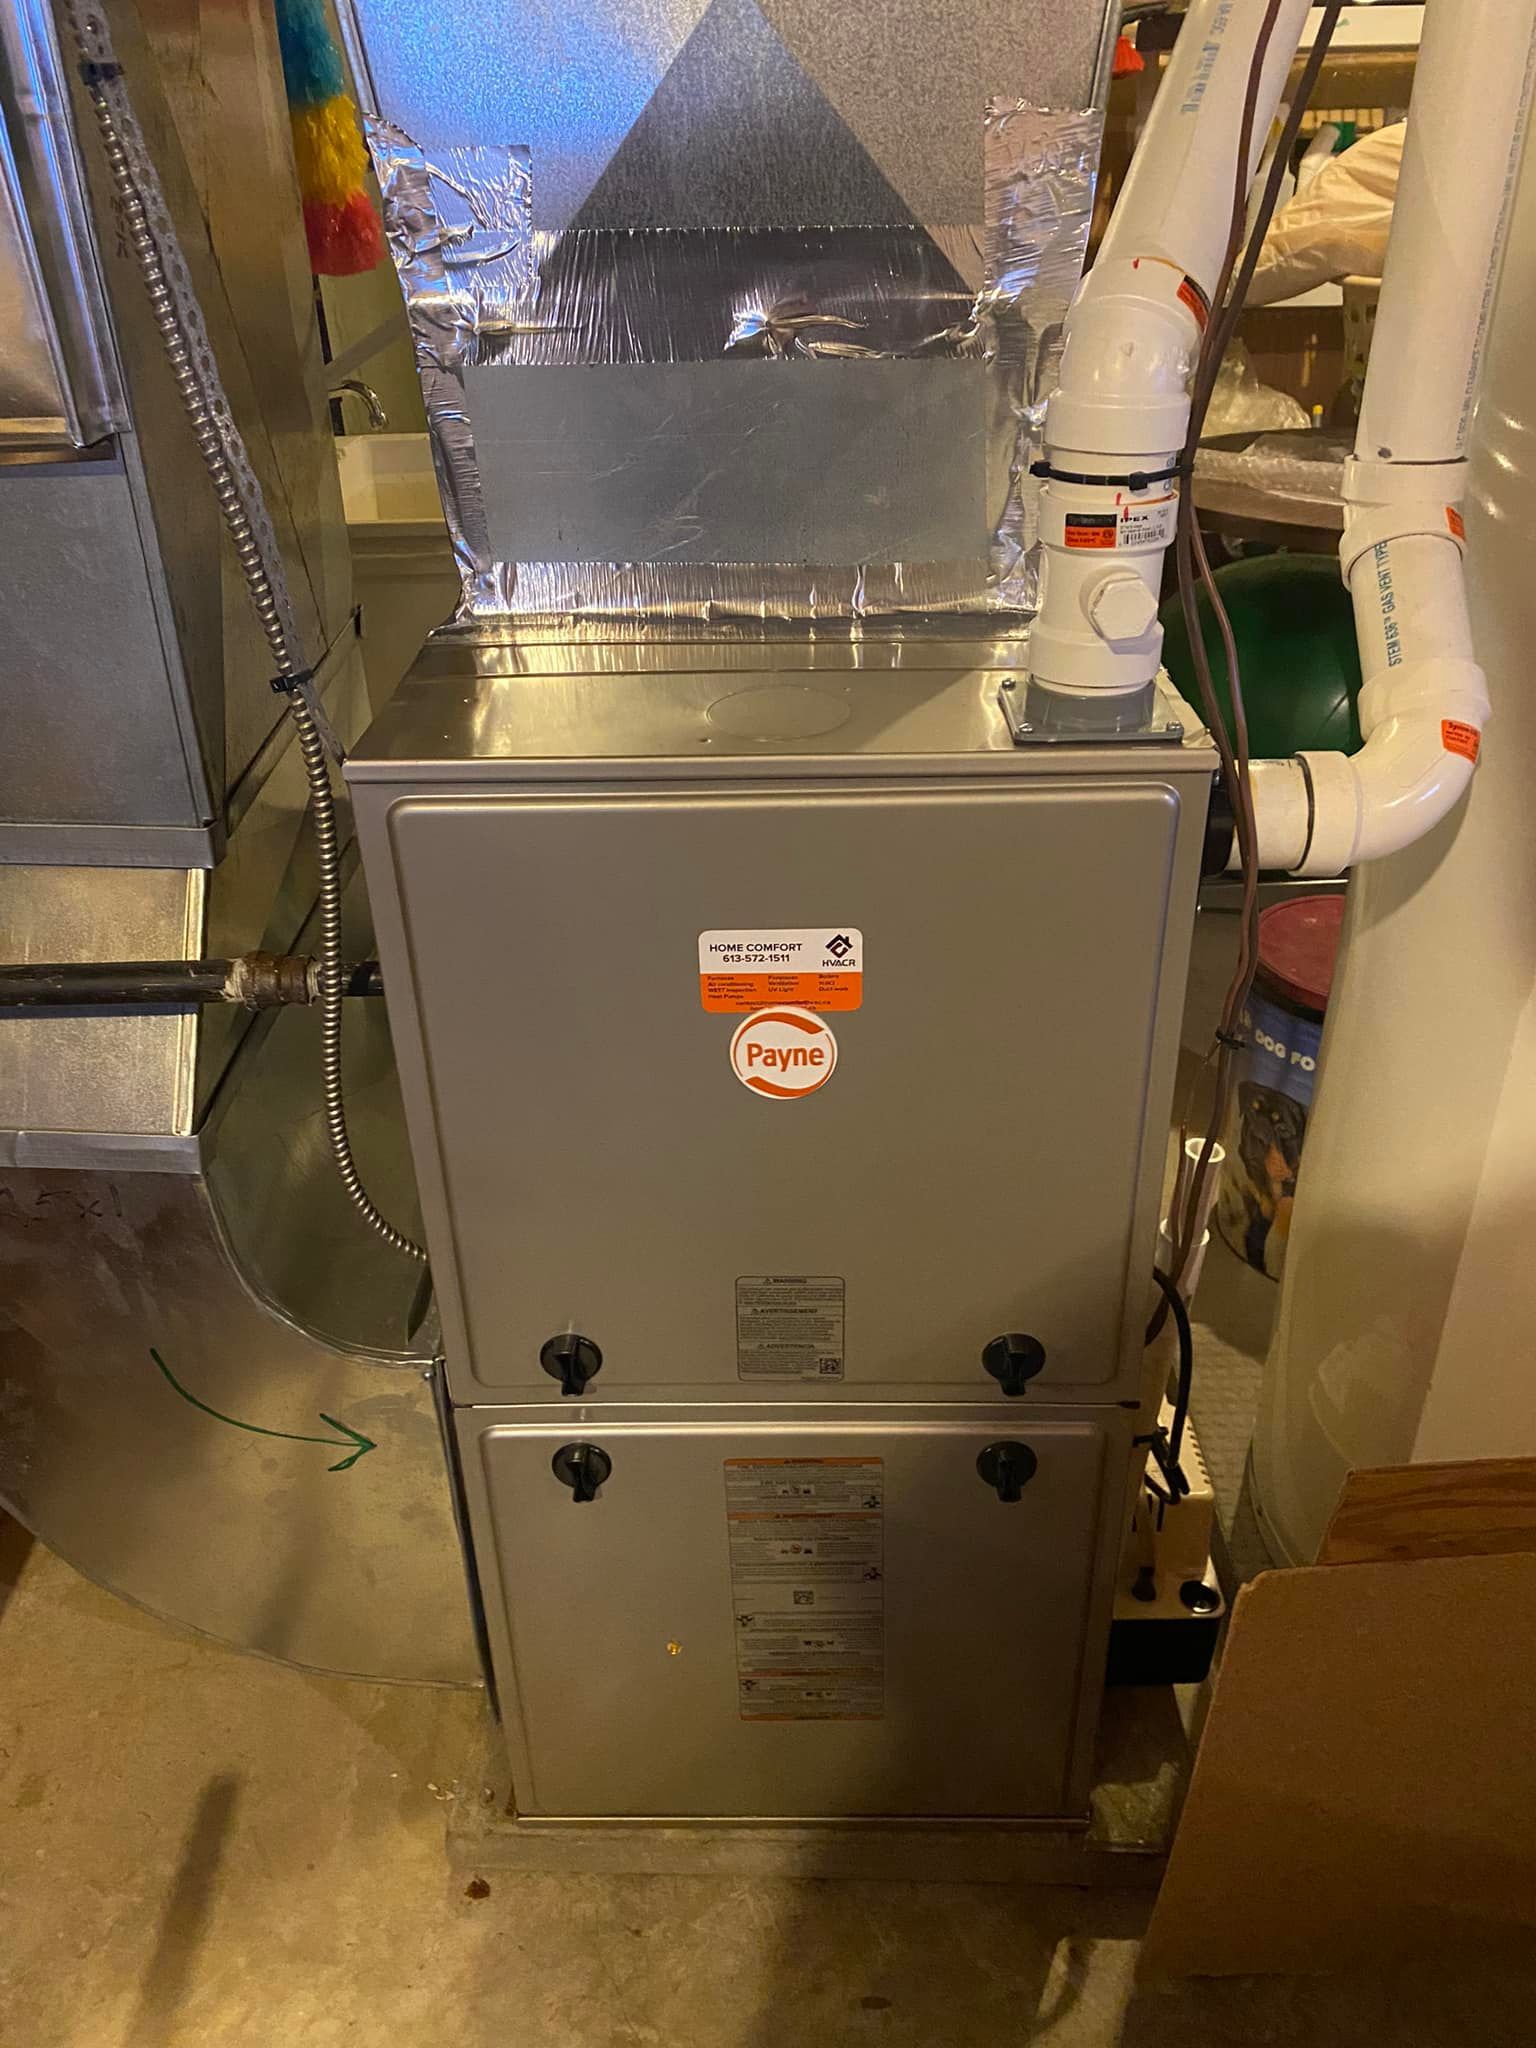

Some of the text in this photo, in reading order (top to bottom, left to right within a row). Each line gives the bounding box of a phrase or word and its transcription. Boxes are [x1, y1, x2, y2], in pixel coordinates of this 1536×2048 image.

[1377, 567, 1392, 593] VENT
[1380, 591, 1396, 614] GAS
[709, 943, 803, 952] HOME COMFORT
[722, 954, 790, 963] 613-572-1511
[822, 959, 856, 967] HVACR
[1255, 1029, 1286, 1058] DOG
[746, 1043, 825, 1073] Payne
